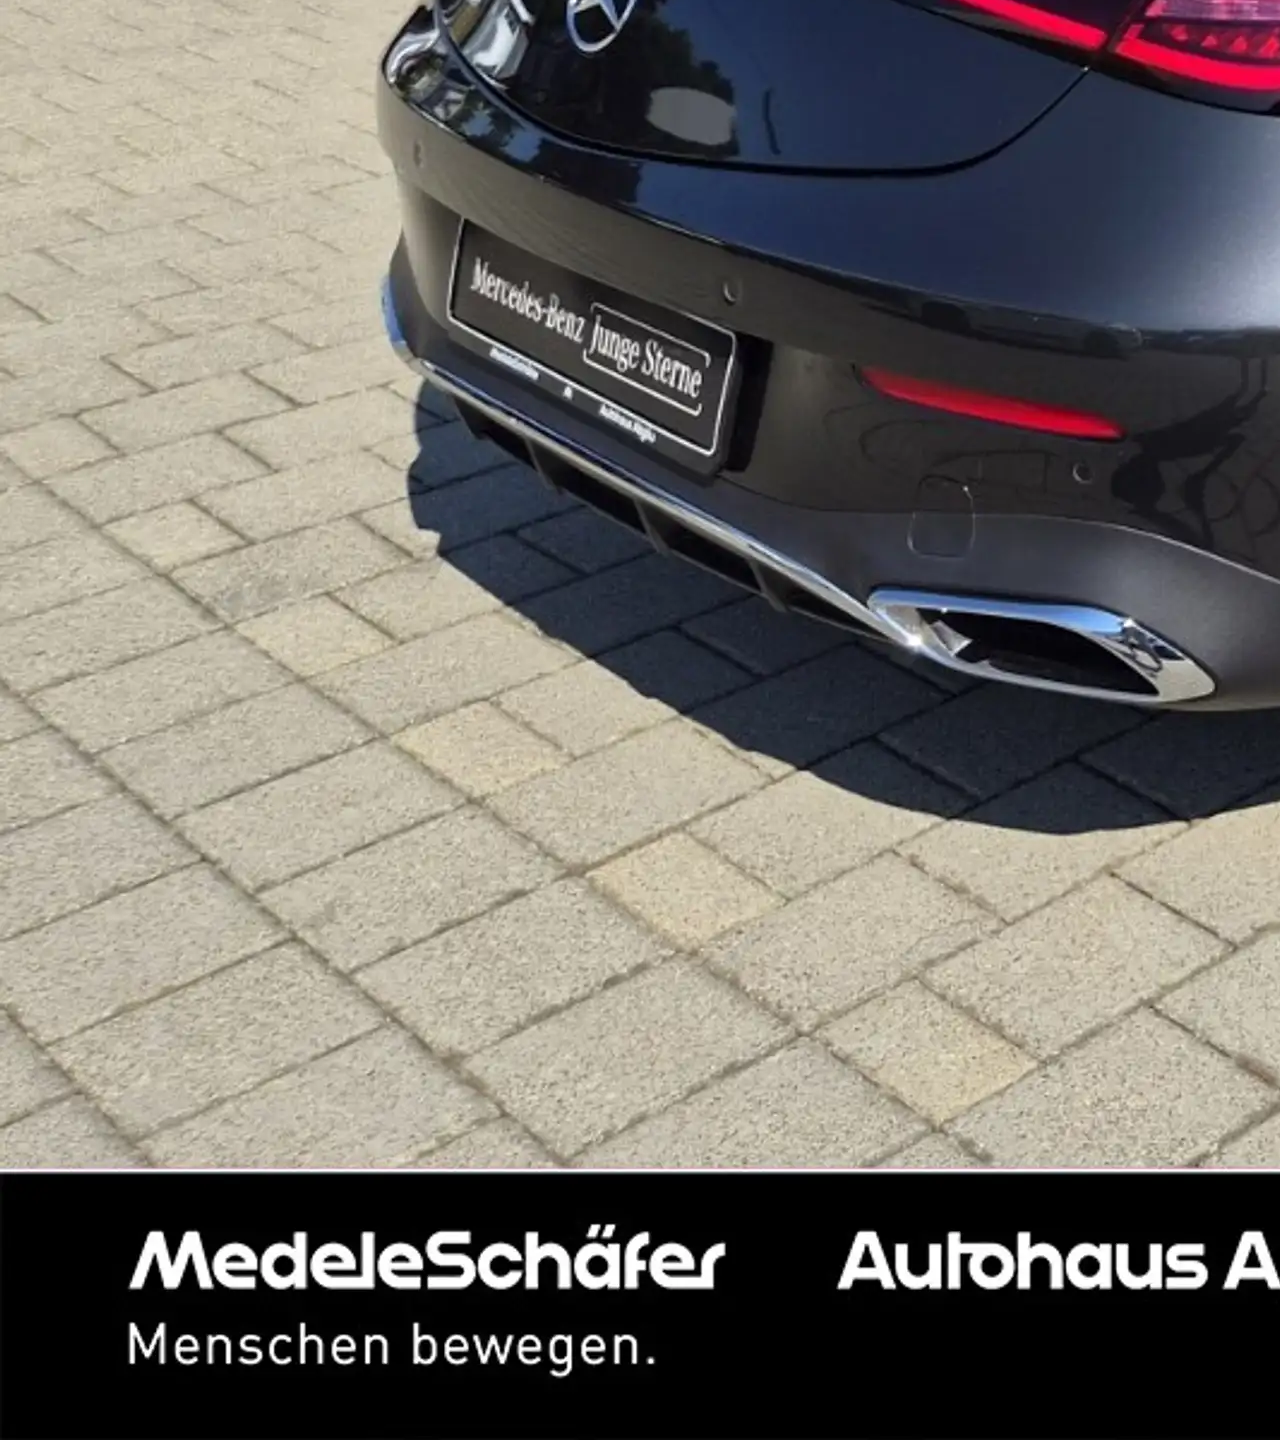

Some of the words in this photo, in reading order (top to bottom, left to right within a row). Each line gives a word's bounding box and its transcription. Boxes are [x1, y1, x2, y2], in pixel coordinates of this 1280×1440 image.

[470, 257, 586, 344] Mercedes-Benz
[589, 314, 641, 373] Junge
[641, 338, 702, 398] Sterne
